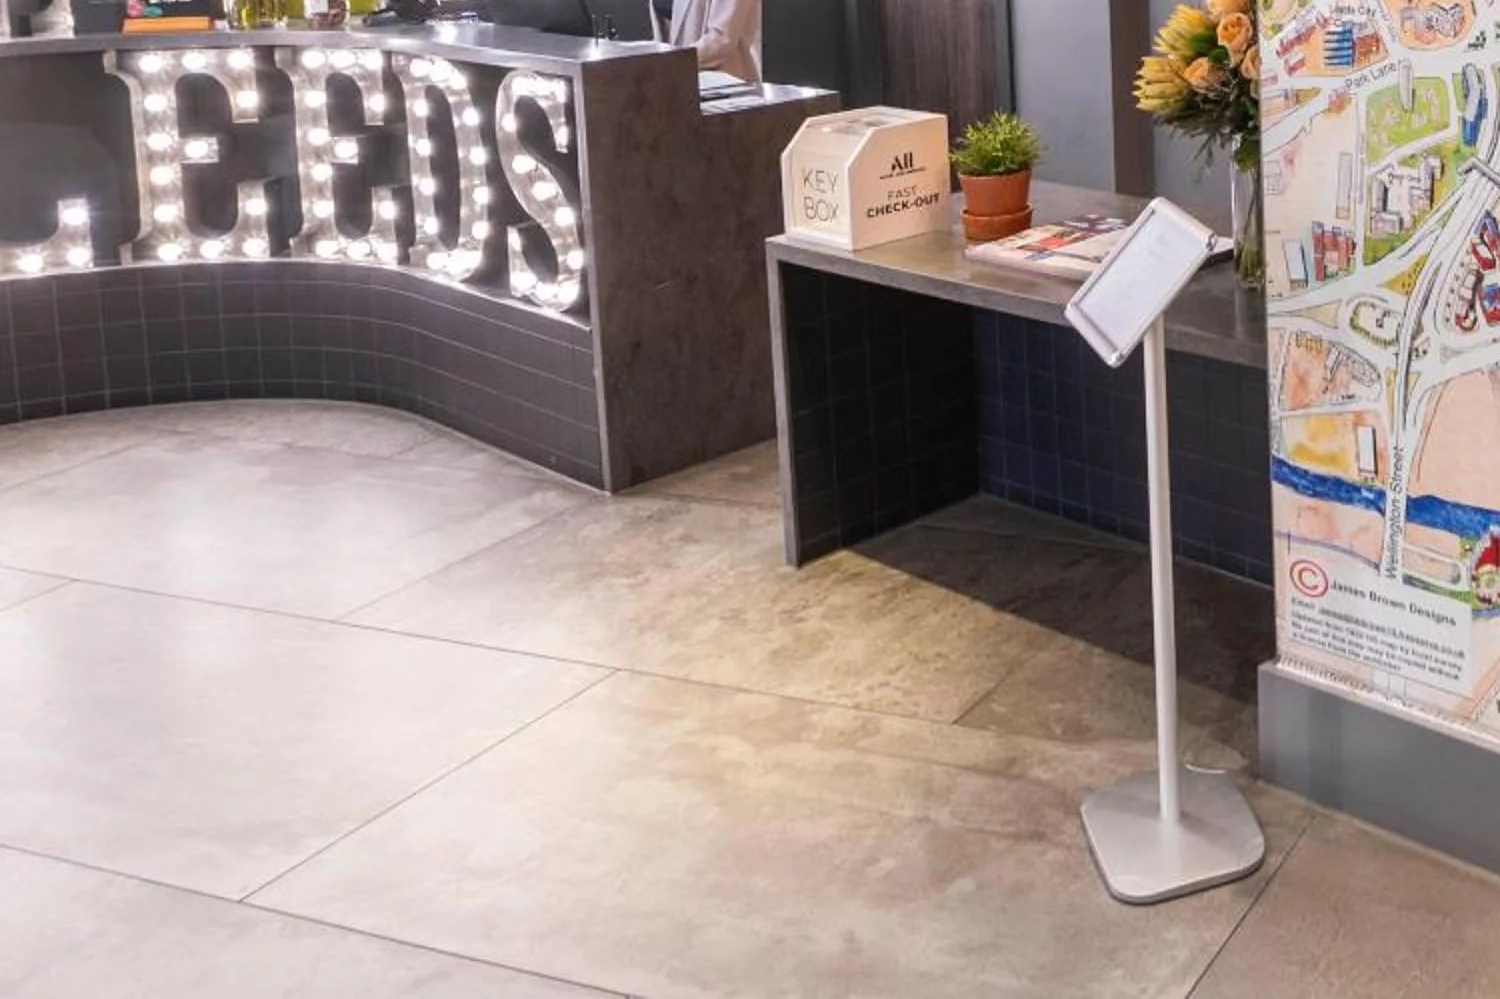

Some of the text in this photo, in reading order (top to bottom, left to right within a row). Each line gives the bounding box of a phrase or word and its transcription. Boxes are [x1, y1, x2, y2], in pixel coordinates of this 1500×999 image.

[802, 168, 839, 195] KEY
[887, 184, 918, 202] FAST
[802, 196, 839, 222] BOX
[866, 191, 941, 219] CHECK-OUT
[1408, 602, 1458, 628] Designs
